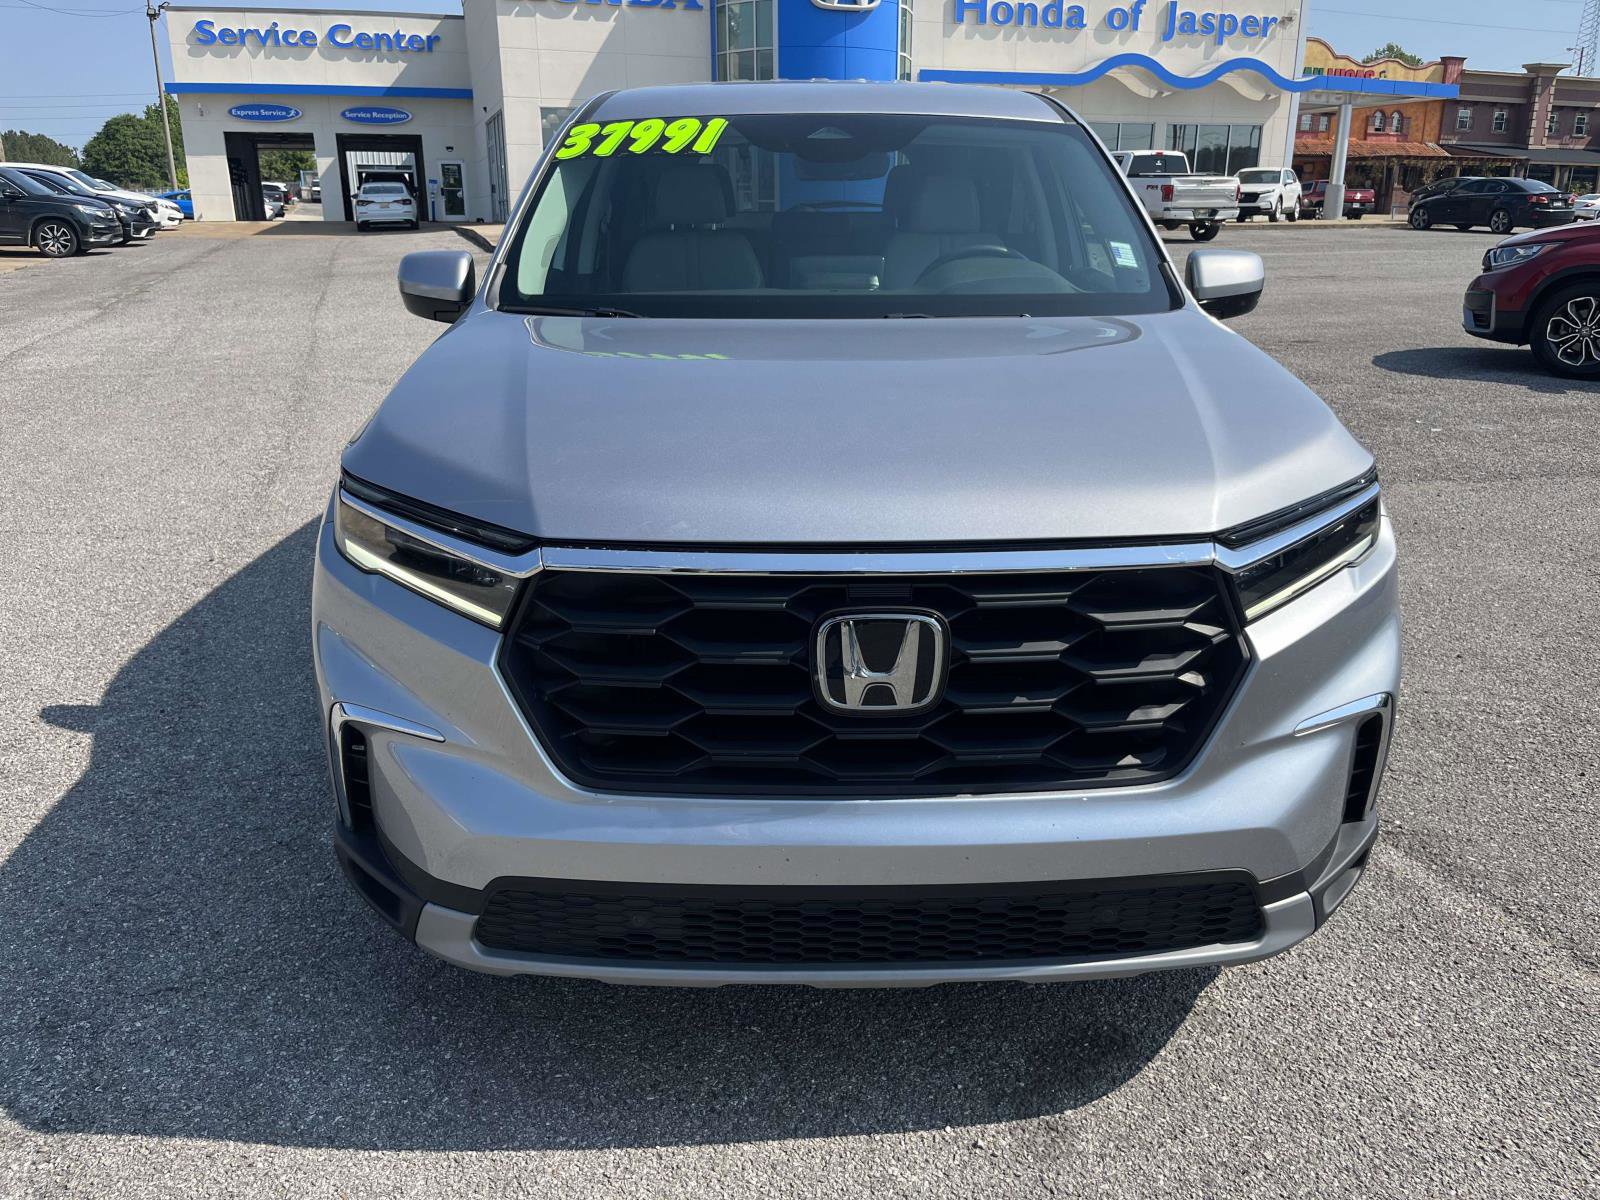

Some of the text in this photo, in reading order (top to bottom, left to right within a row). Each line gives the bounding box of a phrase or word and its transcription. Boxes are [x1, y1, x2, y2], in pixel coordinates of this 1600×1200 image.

[194, 20, 441, 52] Service Center
[954, 0, 1278, 45] Honda of Jasper
[231, 108, 287, 117] Express Service
[345, 111, 407, 120] Service Reception
[555, 118, 728, 159] 37991
